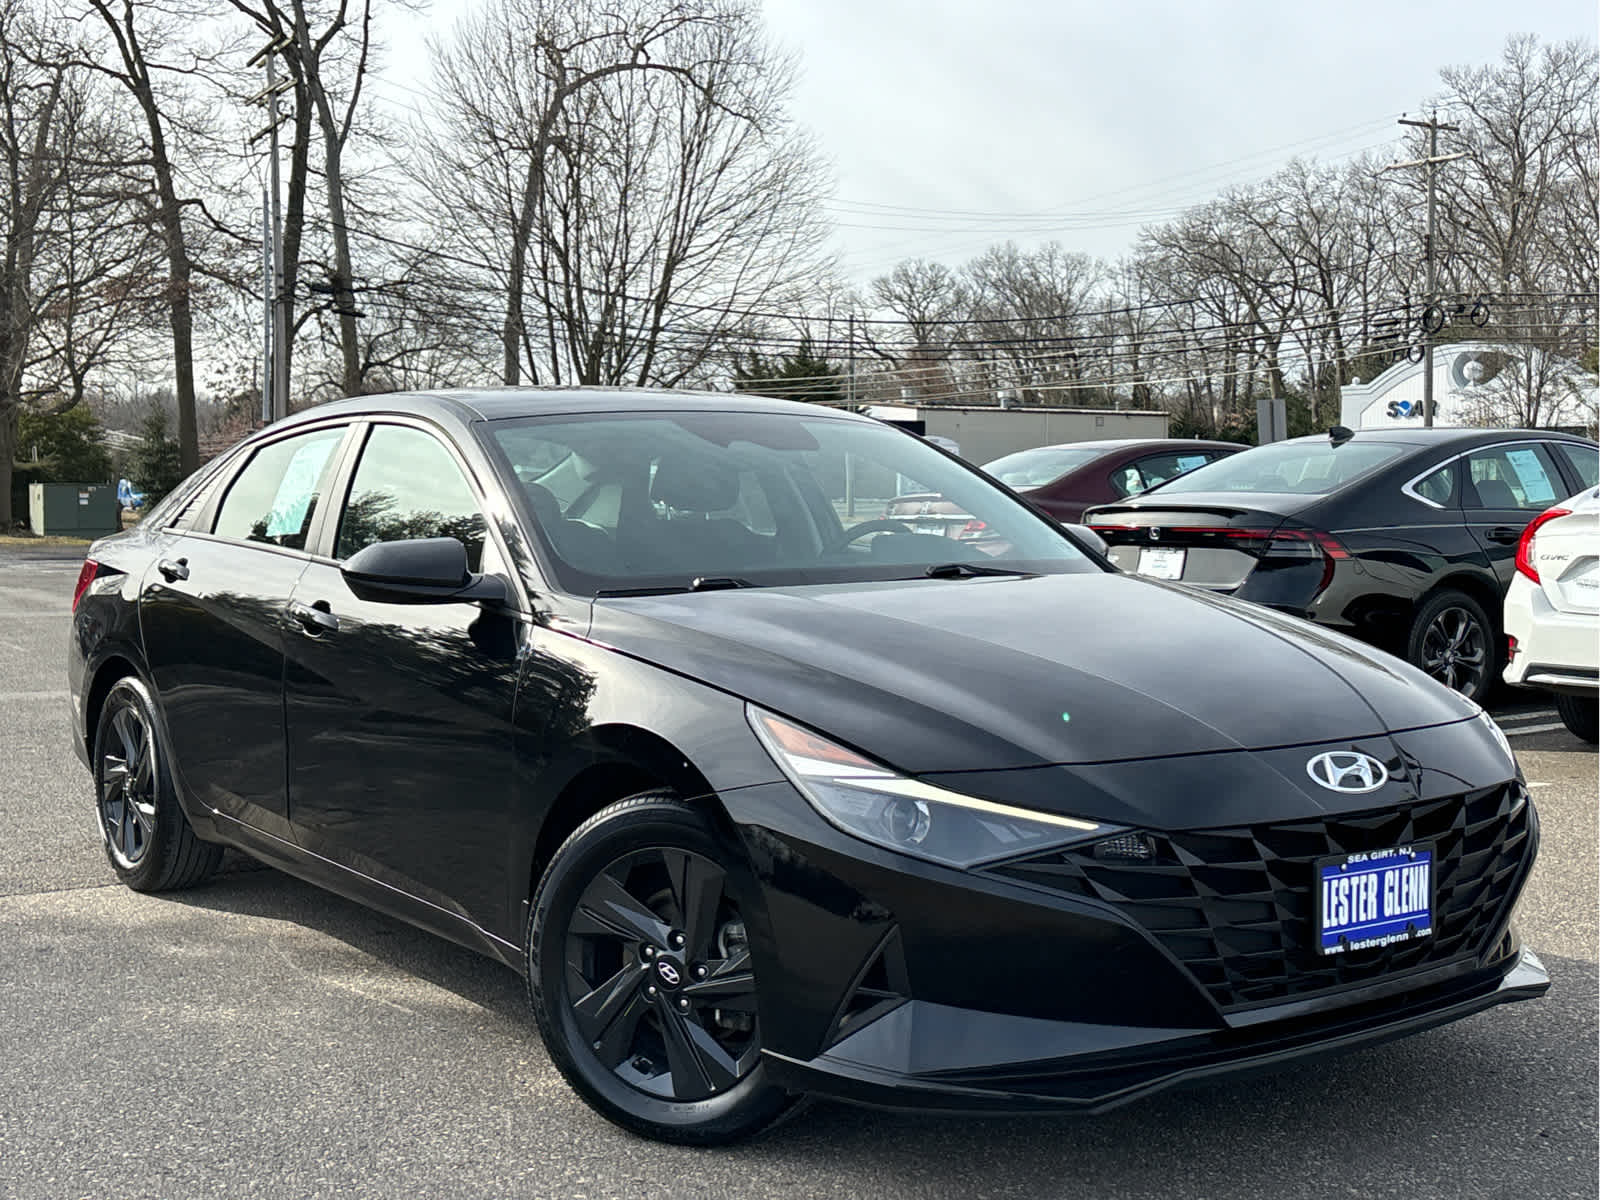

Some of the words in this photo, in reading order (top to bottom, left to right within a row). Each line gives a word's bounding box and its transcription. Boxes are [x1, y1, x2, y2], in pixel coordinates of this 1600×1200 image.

[1347, 854, 1368, 864] SEA
[1399, 846, 1412, 856] NJ
[1323, 874, 1378, 928] LESTER
[1384, 864, 1428, 917] GLENN
[1350, 933, 1408, 951] lesterglenn
